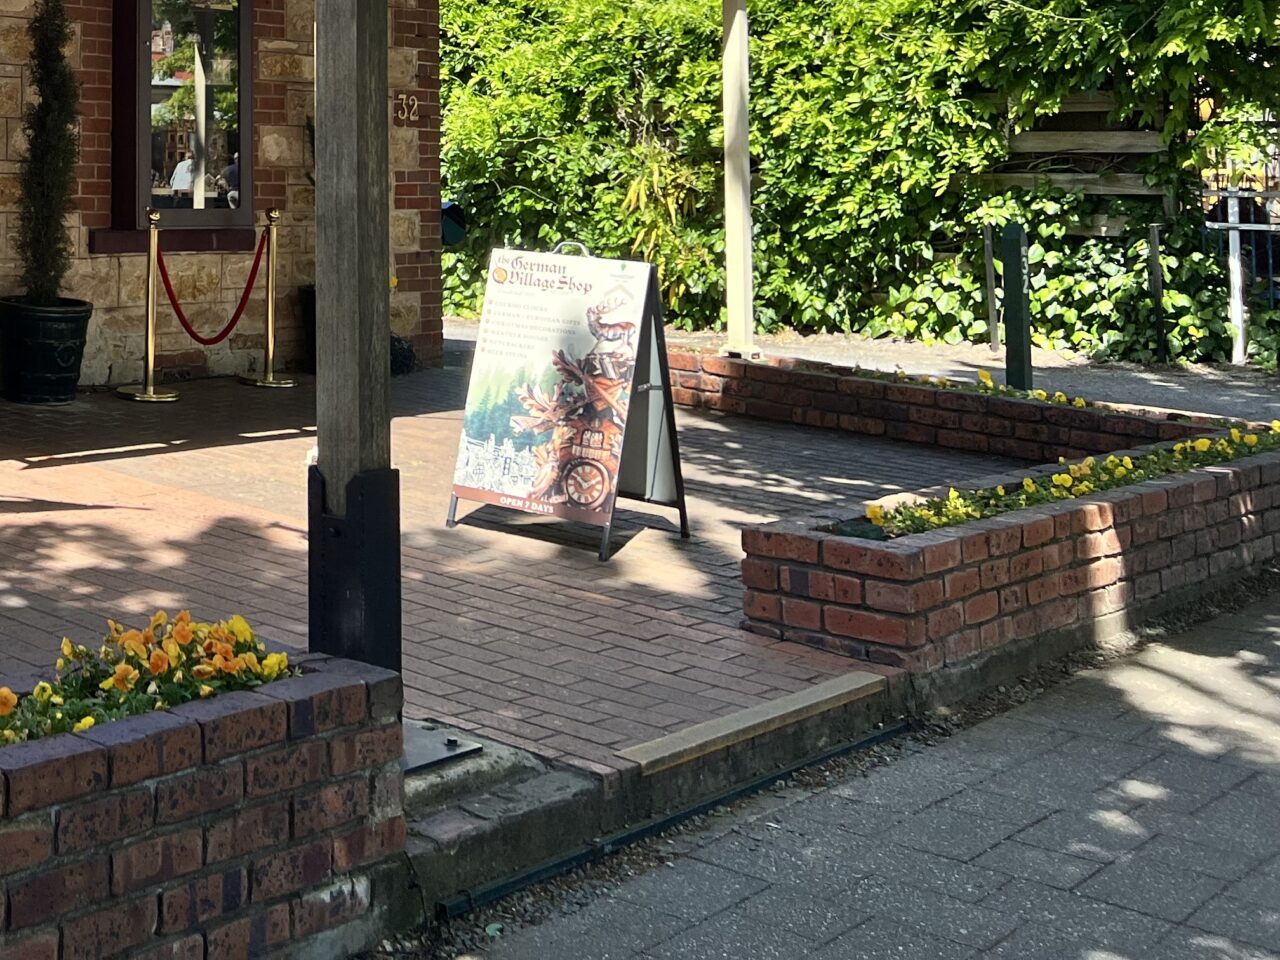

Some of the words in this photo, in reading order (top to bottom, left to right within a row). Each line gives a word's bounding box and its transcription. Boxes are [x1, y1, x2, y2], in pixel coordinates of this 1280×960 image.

[398, 94, 420, 121] 32
[511, 255, 567, 275] German
[508, 270, 556, 292] Village
[556, 275, 593, 295] Shop
[500, 496, 524, 508] OPEN
[531, 502, 554, 513] DAYS
